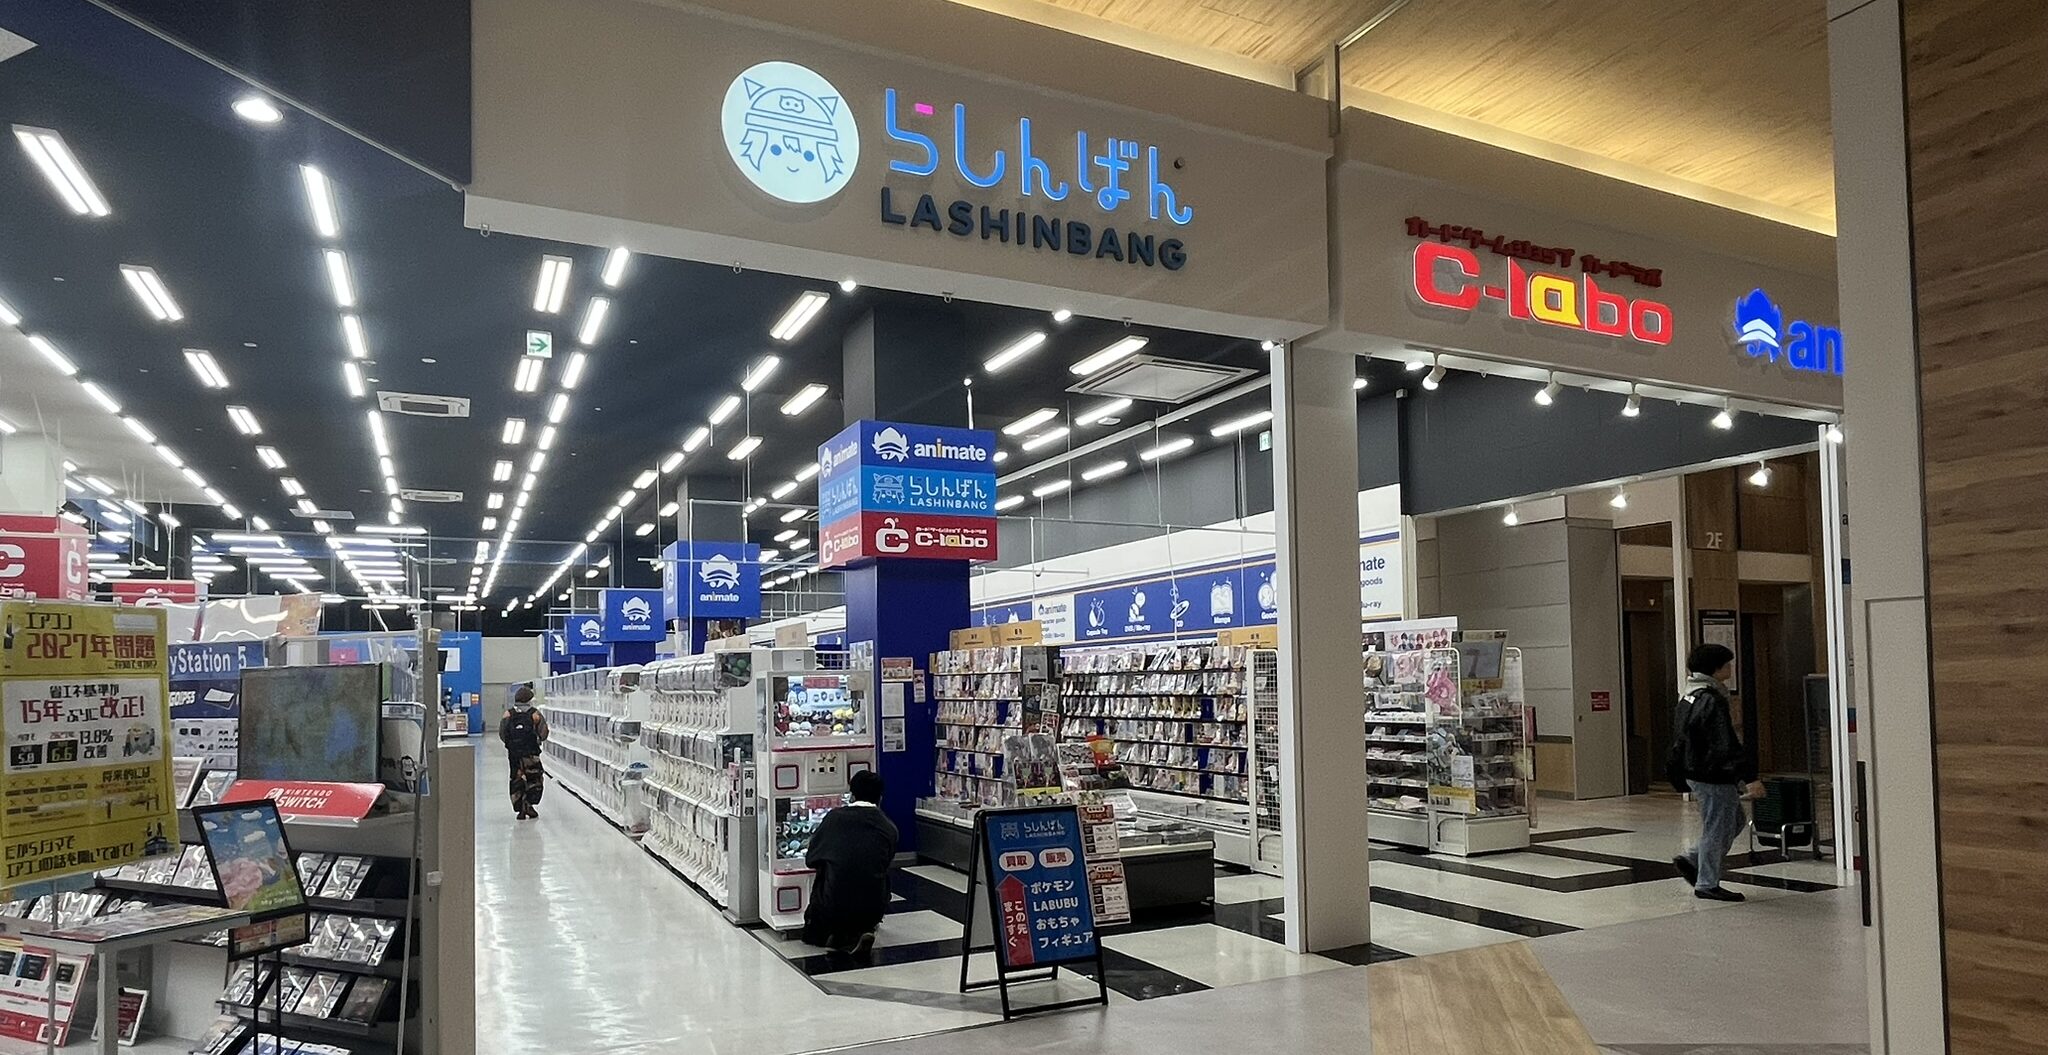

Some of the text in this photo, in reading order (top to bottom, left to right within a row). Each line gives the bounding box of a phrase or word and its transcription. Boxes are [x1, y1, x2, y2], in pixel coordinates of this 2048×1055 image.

[885, 87, 1193, 225] らしんばん
[880, 186, 1187, 272] LASHINBANG
[1413, 241, 1673, 346] C-labo
[914, 438, 987, 462] animate
[910, 476, 987, 499] らしんばん
[910, 498, 987, 510] LASHINBANG
[915, 532, 988, 548] C-labo
[1706, 531, 1723, 549] 2F
[700, 593, 740, 602] animate
[26, 633, 157, 660] 2027年問題
[238, 646, 247, 668] 5
[50, 683, 120, 699] 省エネ基準が
[285, 788, 333, 797] NINTENDO
[278, 797, 328, 809] SWITCH
[1023, 818, 1065, 833] らしんばん
[1005, 852, 1067, 867] 買取 販売
[1030, 880, 1074, 895] ポケモン
[1033, 896, 1079, 912] LABUBU
[1003, 901, 1018, 948] まっすぐ
[1014, 900, 1028, 935] この先
[1036, 916, 1080, 931] おもちゃ
[1038, 931, 1094, 949] フィギュア
